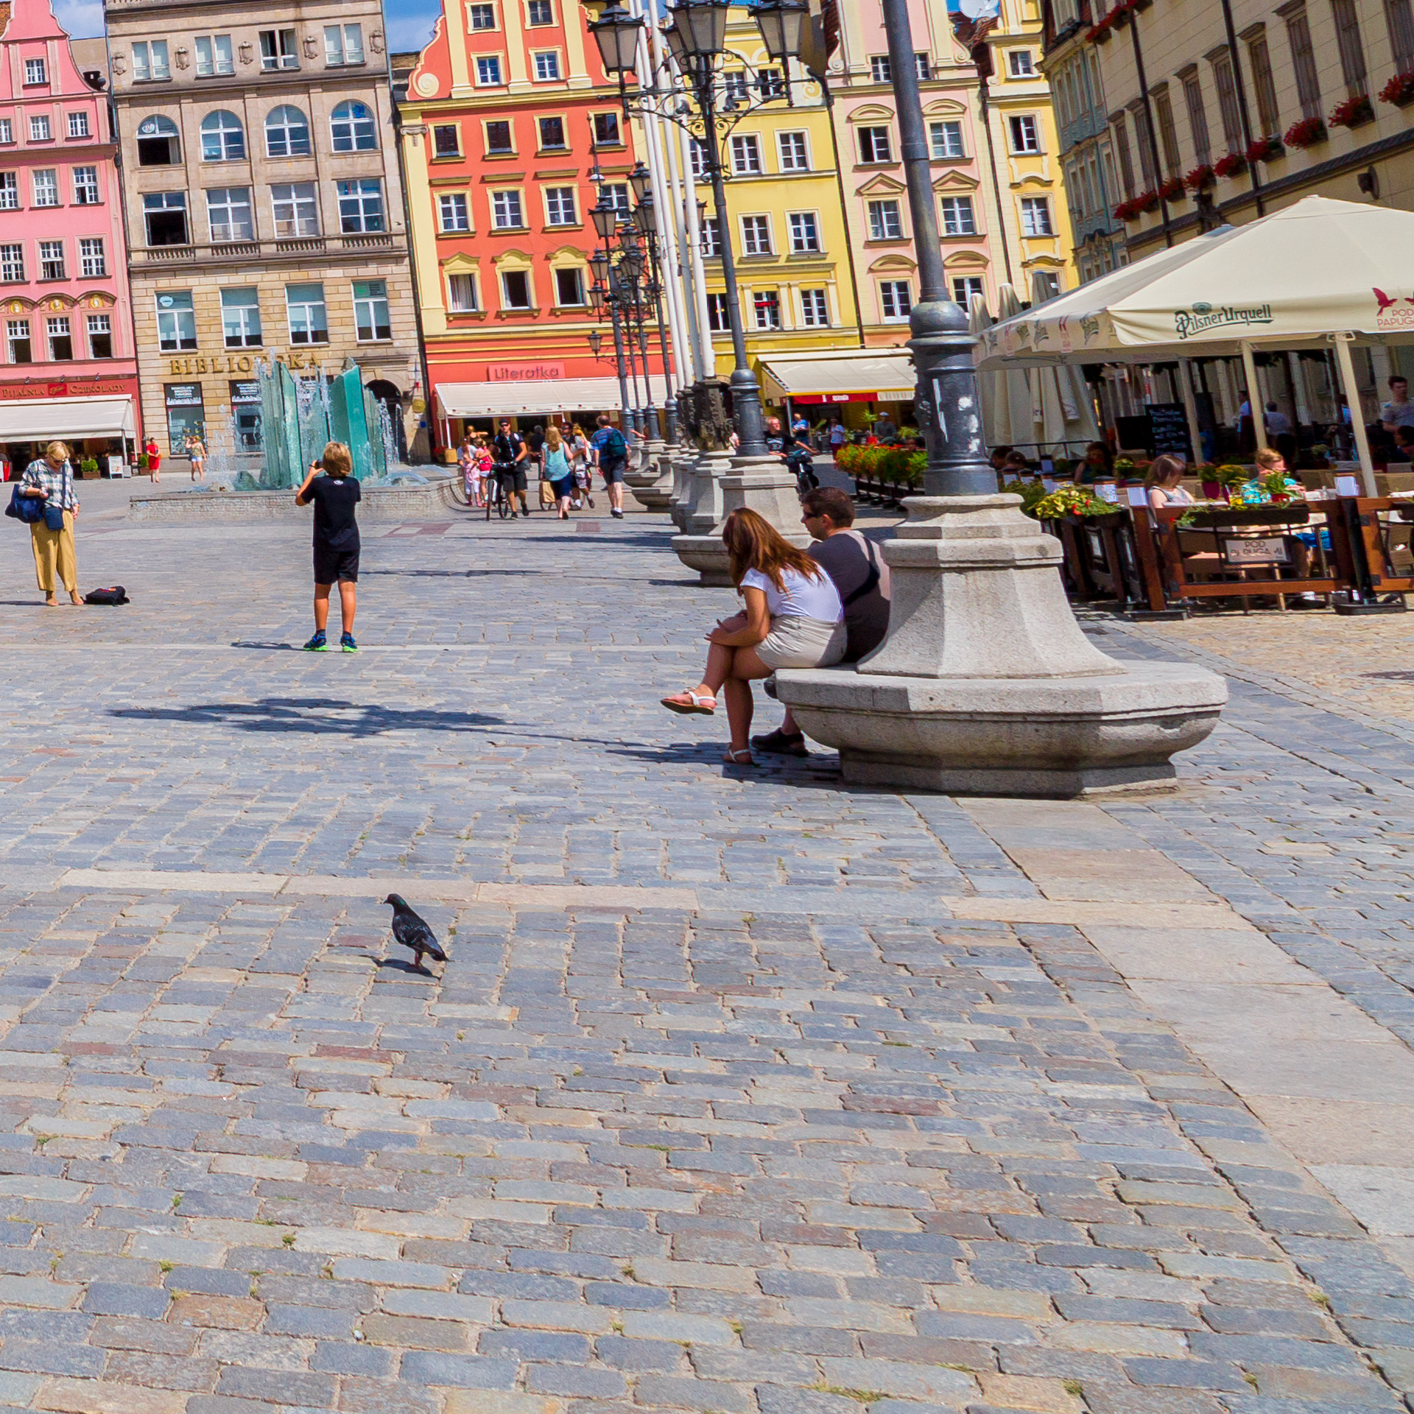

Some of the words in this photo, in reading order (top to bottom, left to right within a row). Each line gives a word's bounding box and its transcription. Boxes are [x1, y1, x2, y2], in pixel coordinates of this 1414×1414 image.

[1391, 309, 1414, 317] POD
[1174, 309, 1223, 339] Pilsner
[1221, 304, 1272, 326] Urquell
[1377, 317, 1414, 327] PAPUG
[494, 366, 559, 380] Literatka
[1244, 540, 1266, 548] POD
